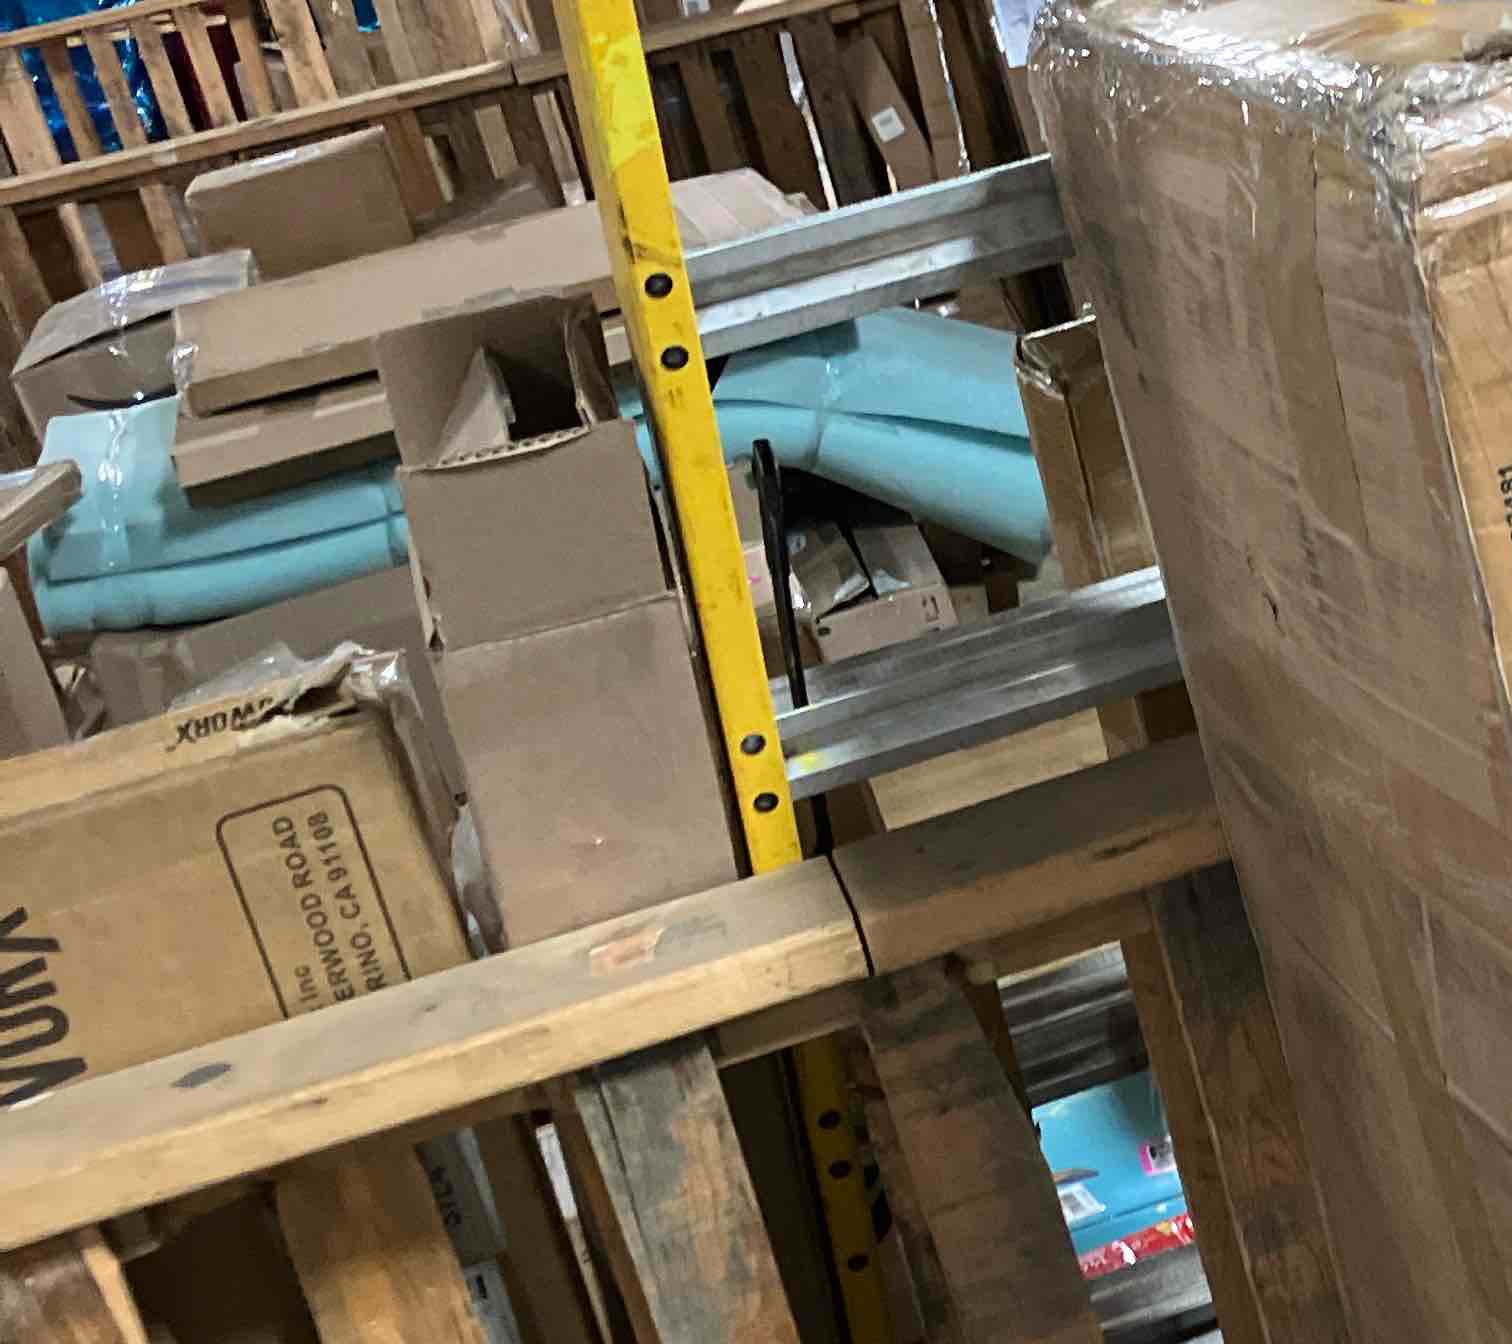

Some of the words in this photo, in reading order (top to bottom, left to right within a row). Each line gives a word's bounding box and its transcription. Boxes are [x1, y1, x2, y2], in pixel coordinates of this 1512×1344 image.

[269, 813, 312, 889] ROAD
[305, 810, 348, 882] 91108
[331, 883, 362, 921] CA
